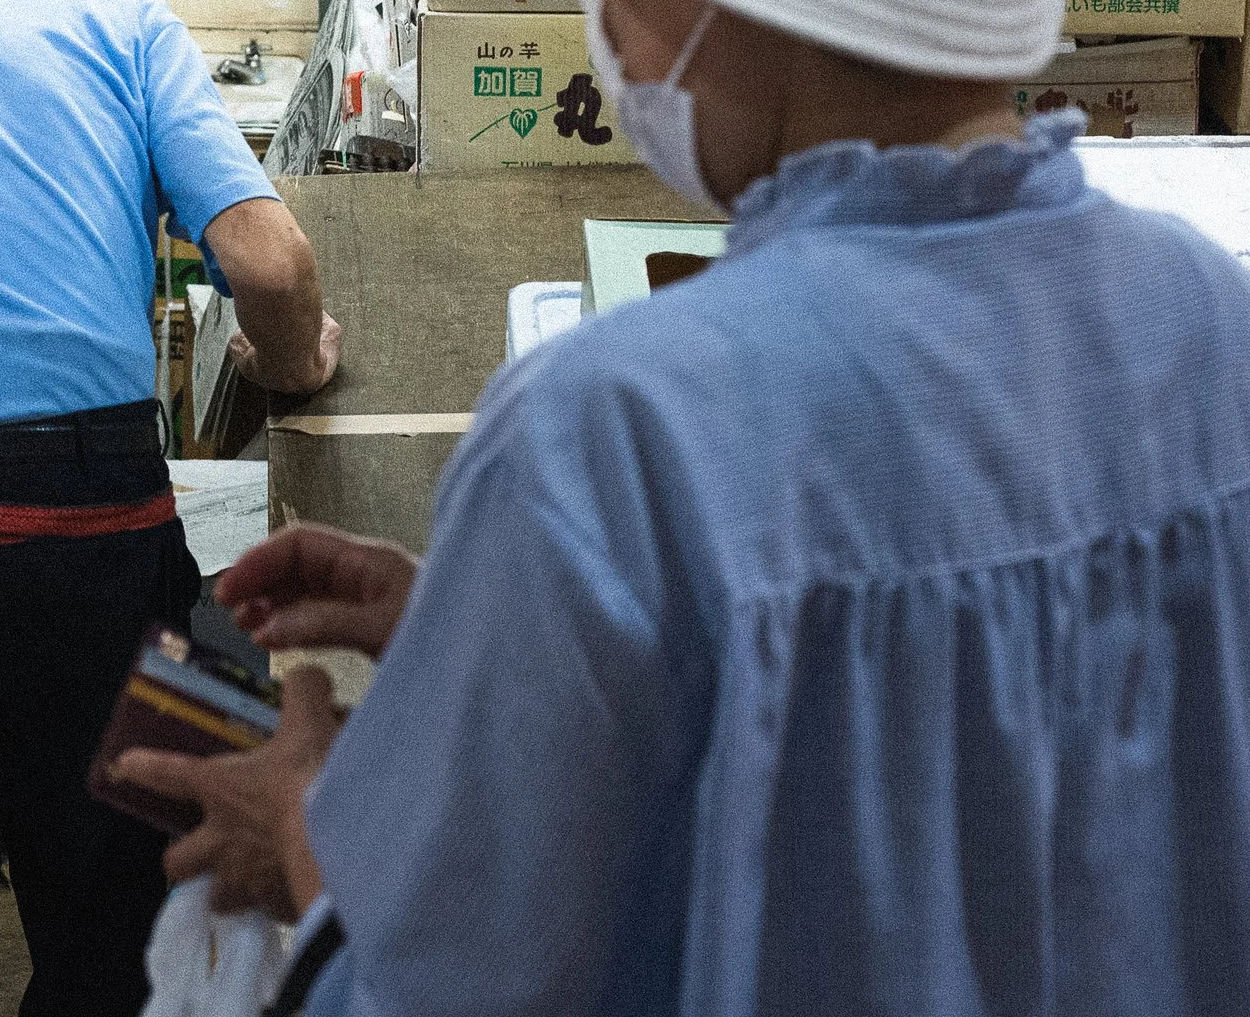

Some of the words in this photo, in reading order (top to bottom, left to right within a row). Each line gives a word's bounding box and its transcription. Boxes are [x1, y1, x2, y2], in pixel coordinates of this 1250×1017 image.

[477, 42, 540, 60] 山の芋
[475, 68, 541, 96] 加賀
[553, 73, 613, 145] 丸
